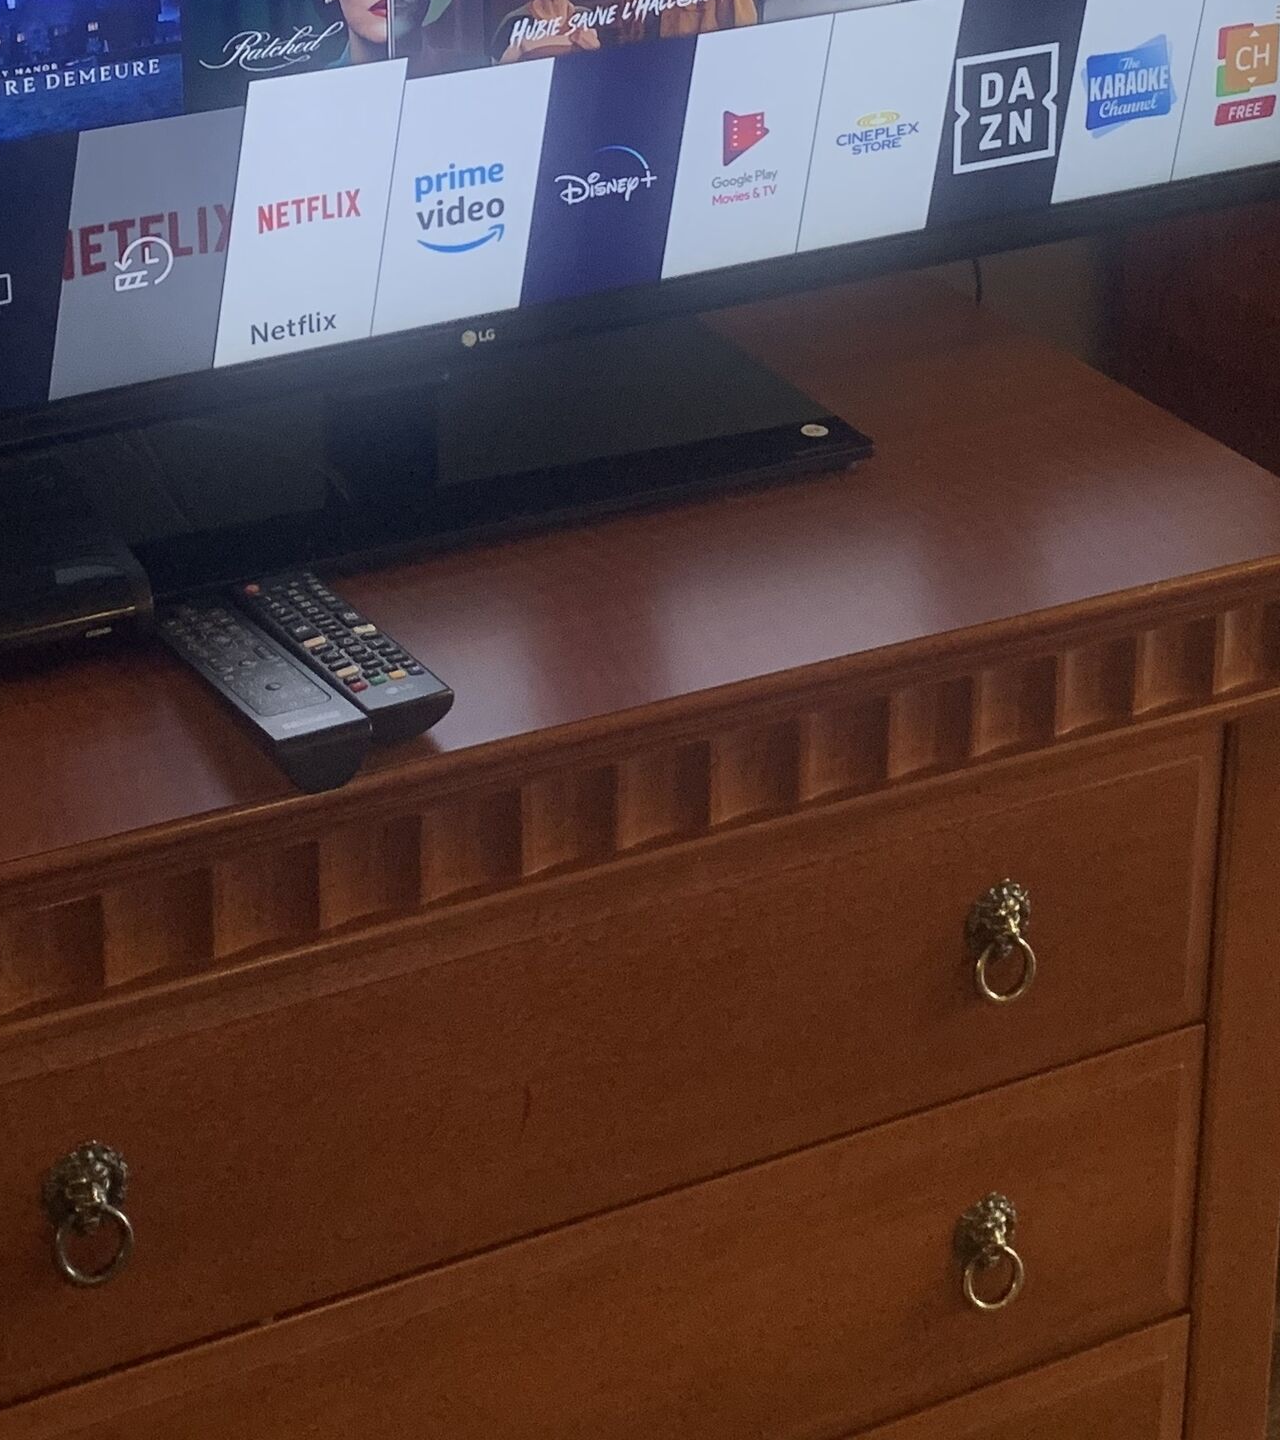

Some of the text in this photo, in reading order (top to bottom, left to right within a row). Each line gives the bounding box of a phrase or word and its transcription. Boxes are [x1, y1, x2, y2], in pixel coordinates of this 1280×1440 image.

[510, 16, 561, 48] HUBIE
[568, 4, 618, 35] SAUVE
[199, 21, 344, 72] Ratched
[1235, 42, 1270, 71] CH
[14, 63, 58, 76] MANOR
[46, 59, 160, 90] DEMEURE
[1120, 57, 1140, 70] The
[1089, 65, 1169, 102] KARAOKE
[1099, 92, 1158, 119] Channel
[1228, 102, 1263, 121] FREE
[836, 121, 920, 147] CINEPLEX
[852, 137, 902, 155] STORE
[415, 162, 504, 203] prime
[712, 169, 778, 190] Google Play
[712, 184, 777, 207] Movies & TV
[258, 188, 361, 234] NETFLIX
[416, 196, 505, 231] video
[250, 312, 337, 345] Netflix
[478, 328, 496, 343] LG
